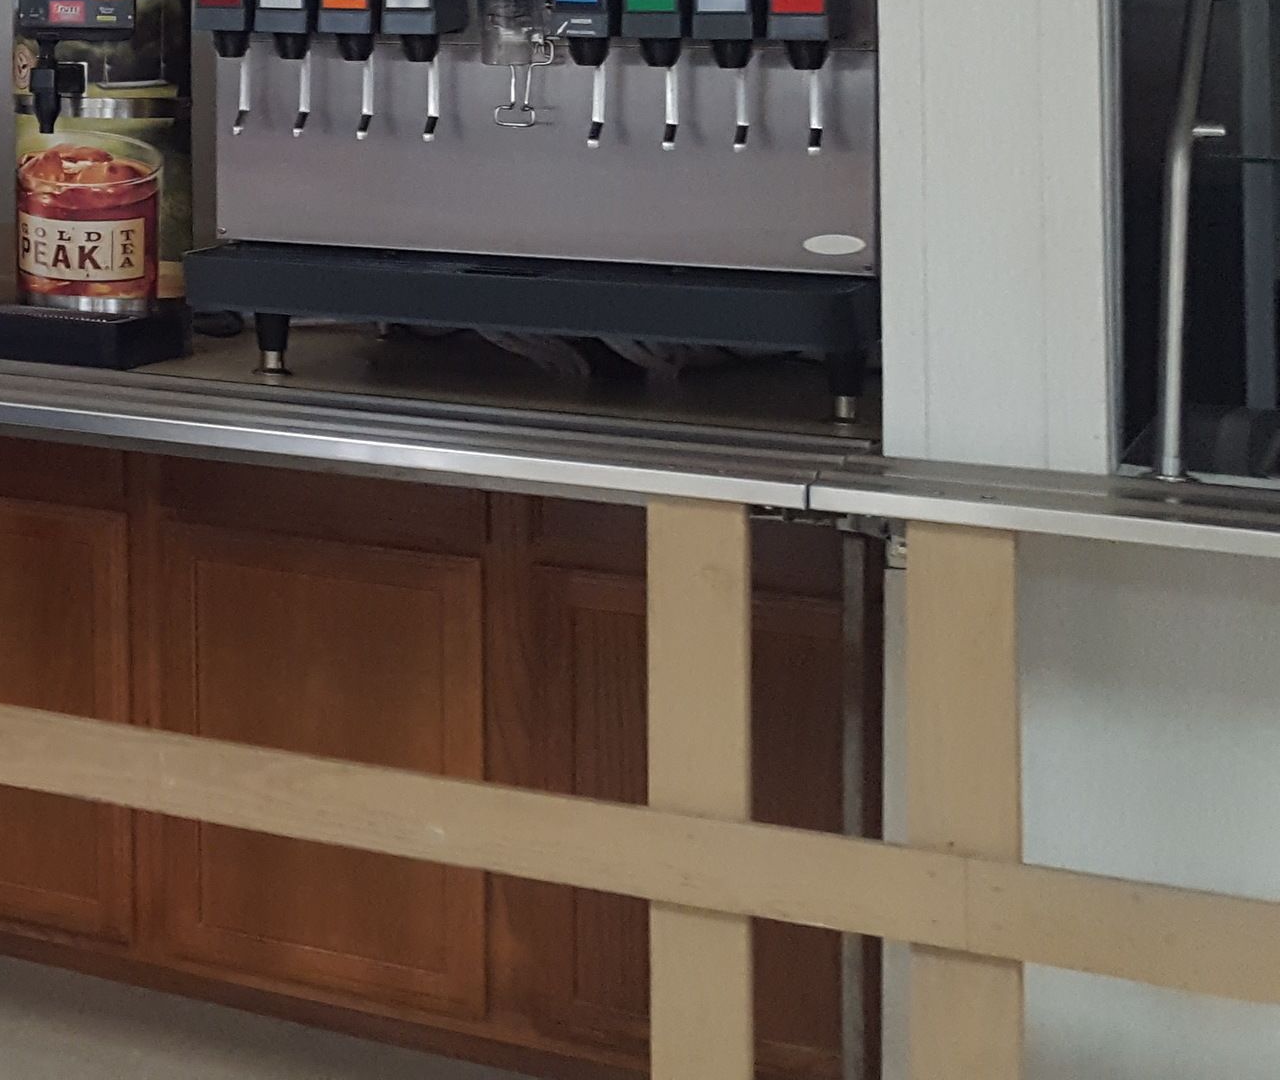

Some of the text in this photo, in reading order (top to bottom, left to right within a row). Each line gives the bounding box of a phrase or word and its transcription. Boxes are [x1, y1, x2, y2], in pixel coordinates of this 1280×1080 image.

[20, 222, 102, 242] GOLD
[119, 228, 135, 269] TEA
[20, 236, 102, 271] PEAK
